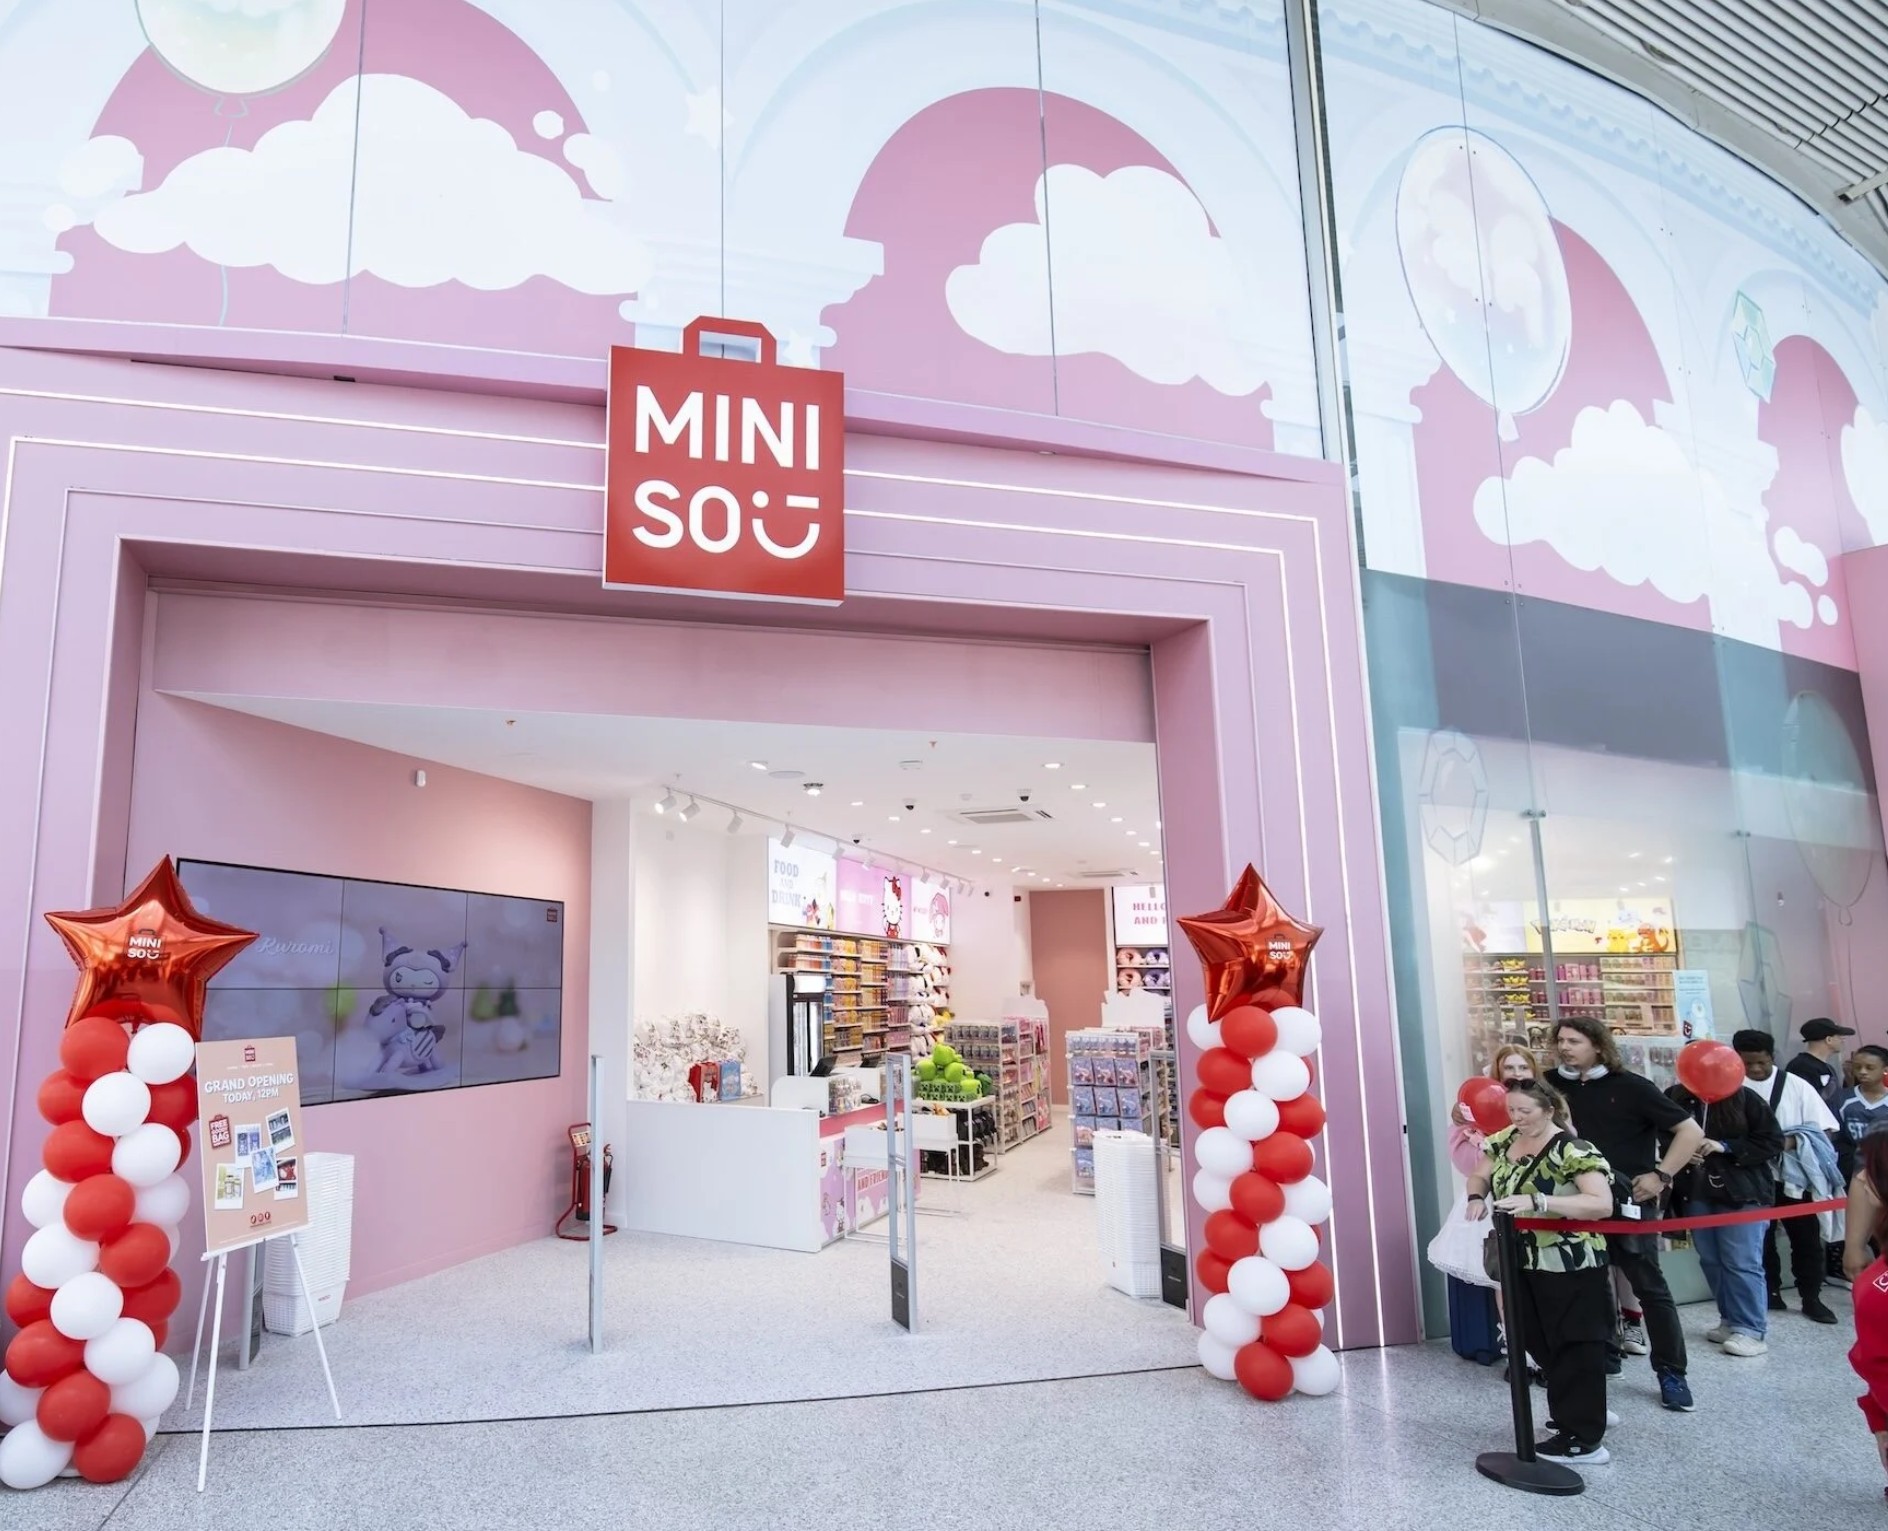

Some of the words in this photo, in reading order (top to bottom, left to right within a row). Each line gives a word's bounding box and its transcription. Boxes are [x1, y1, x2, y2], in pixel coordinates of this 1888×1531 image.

[635, 384, 820, 470] MINI
[774, 859, 799, 878] FOOD
[771, 889, 801, 908] DRINK
[1134, 916, 1158, 925] AND
[129, 936, 162, 949] MINI
[257, 937, 334, 956] Kuromi
[1268, 941, 1291, 950] MINI
[205, 1077, 245, 1093] GRAND
[248, 1072, 294, 1087] OPENING
[223, 1091, 255, 1103] TODAY,
[258, 1088, 279, 1098] 12PM
[212, 1131, 230, 1143] BAG
